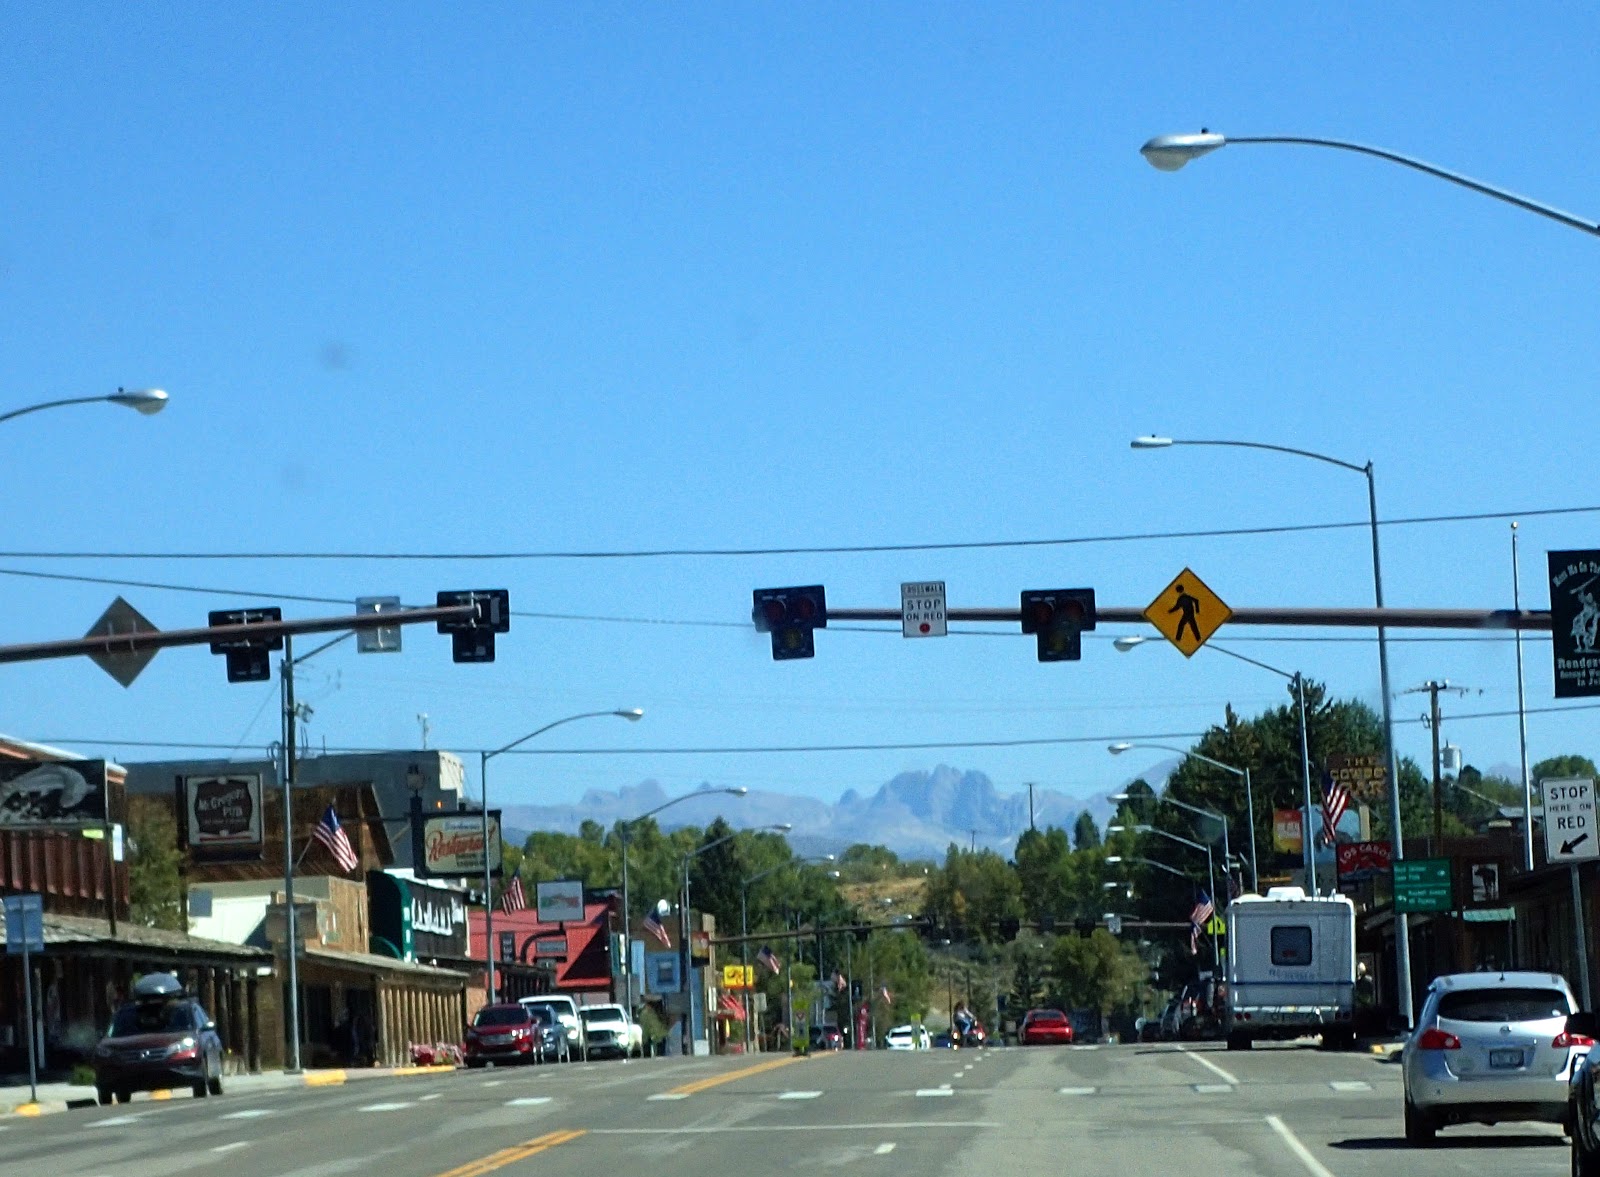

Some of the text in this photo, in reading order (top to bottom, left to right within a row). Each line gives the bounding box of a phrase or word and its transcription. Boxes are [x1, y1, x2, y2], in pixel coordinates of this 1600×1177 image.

[907, 600, 941, 611] STOP
[906, 611, 943, 621] ON RED
[1345, 756, 1376, 767] THE
[1550, 785, 1588, 800] STOP
[222, 804, 243, 818] PUB
[1549, 803, 1592, 812] HERE ON
[1557, 815, 1586, 830] RED
